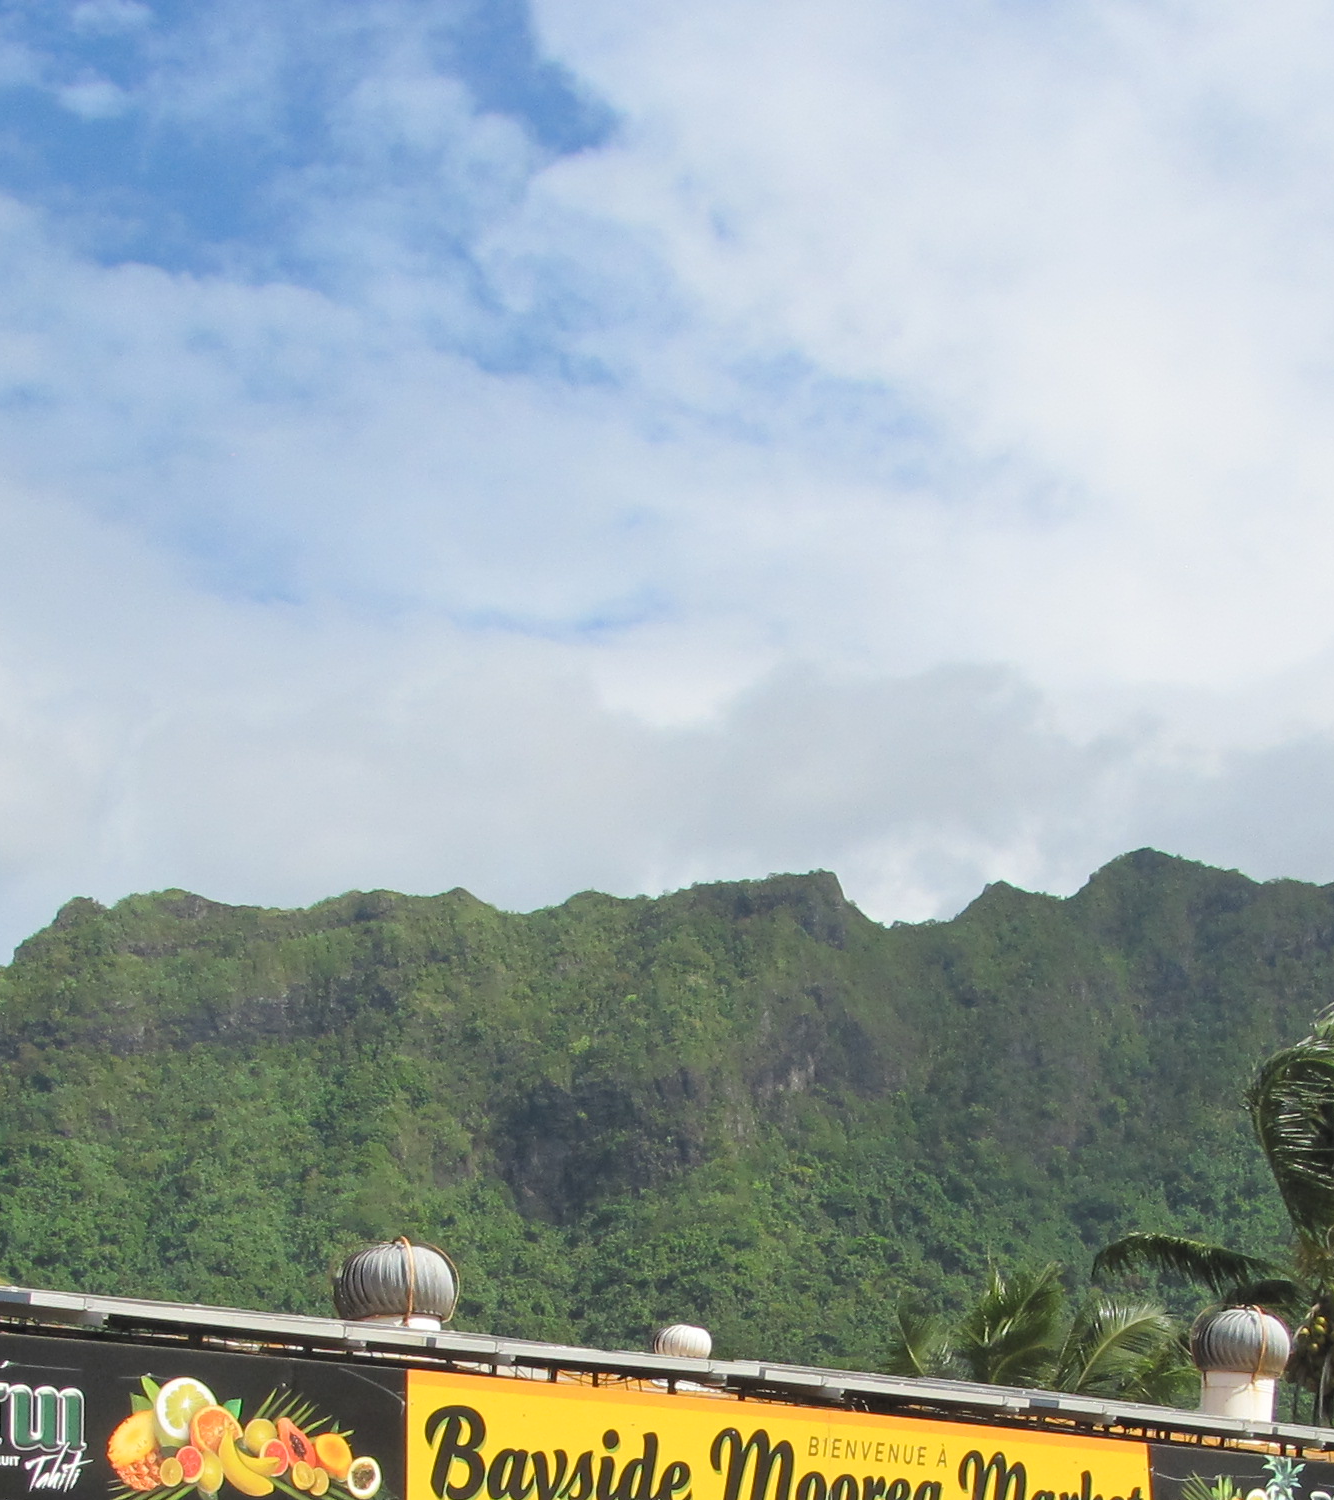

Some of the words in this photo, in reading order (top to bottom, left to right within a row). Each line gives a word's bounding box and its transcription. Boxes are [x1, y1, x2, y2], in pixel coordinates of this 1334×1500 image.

[24, 1442, 94, 1493] Tahiti
[807, 1436, 927, 1466] BIENVENUE
[936, 1443, 948, 1469] À
